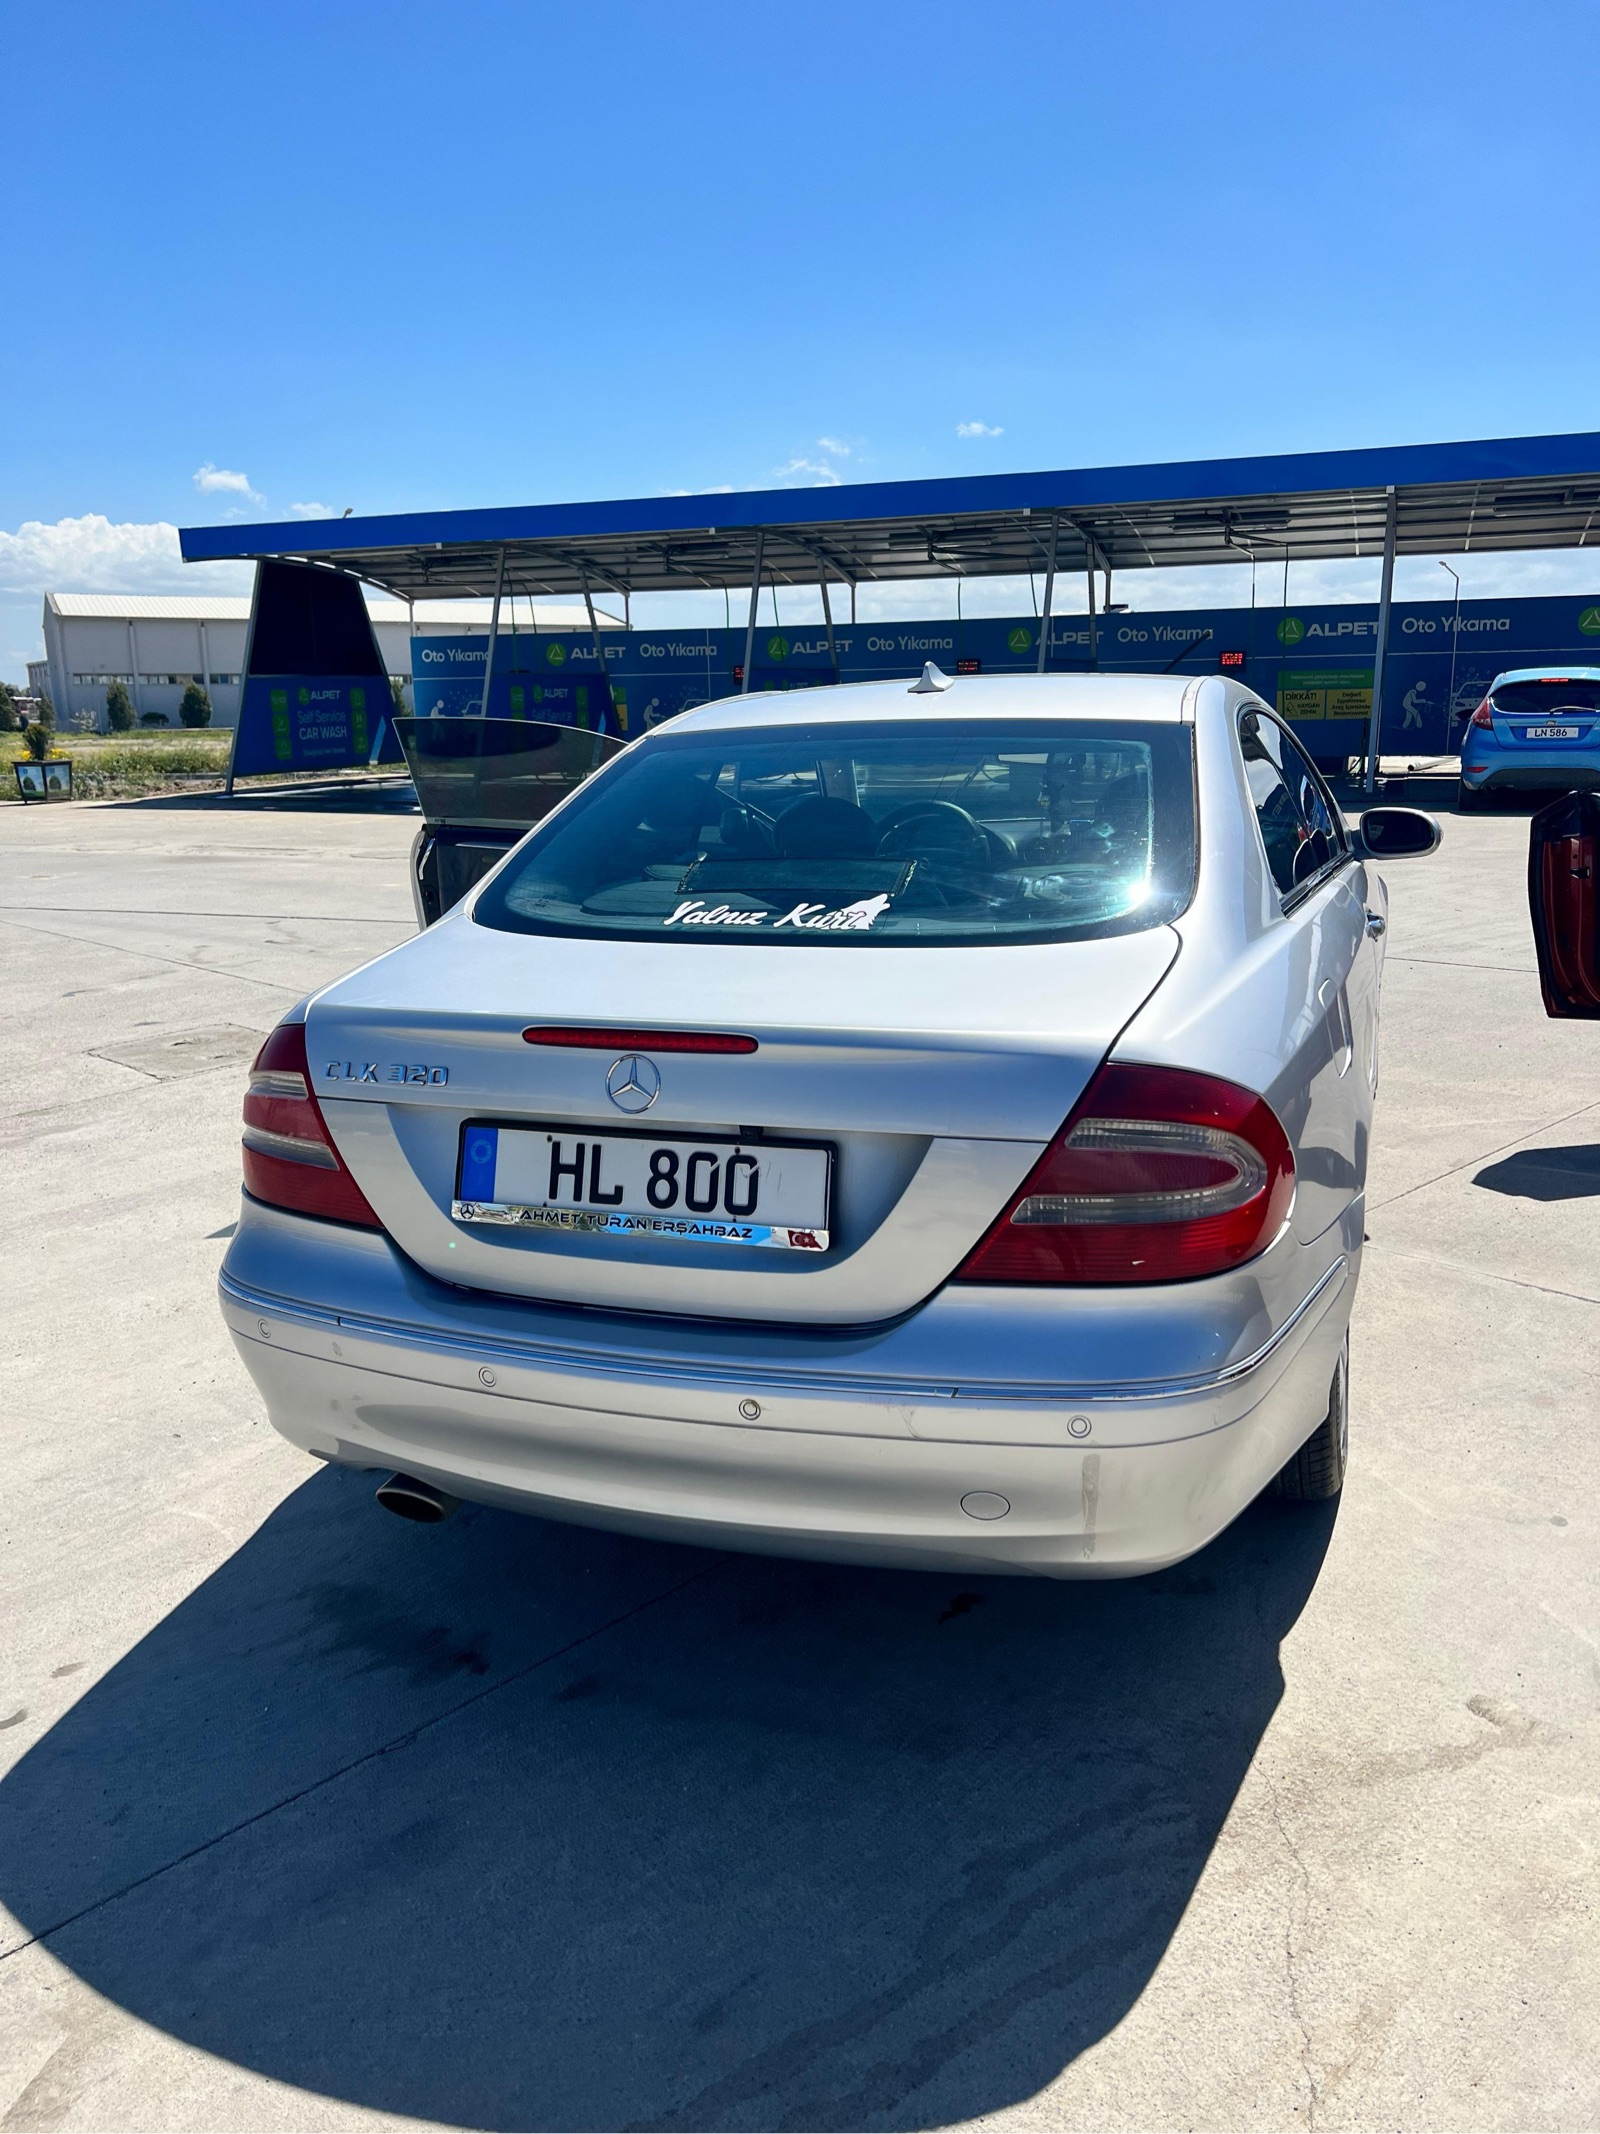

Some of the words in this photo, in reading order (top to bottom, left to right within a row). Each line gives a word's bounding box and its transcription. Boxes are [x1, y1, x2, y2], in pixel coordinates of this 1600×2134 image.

[1306, 621, 1379, 637] ALPET
[1401, 617, 1437, 634] Oto
[1441, 616, 1510, 633] Yıkama
[1117, 627, 1149, 643] Oto
[640, 643, 665, 657] Oto
[667, 642, 717, 657] Yıkama
[867, 636, 895, 651] Oto
[898, 635, 953, 650] Yıkama
[421, 649, 445, 663] Oto
[311, 690, 341, 700] ALPET
[544, 688, 569, 698] ALPET
[297, 710, 314, 724] Self
[315, 709, 346, 723] Service
[300, 727, 319, 740] CAR
[320, 725, 347, 739] WASH
[1534, 728, 1548, 737] LN
[1549, 728, 1567, 737] 586
[663, 901, 768, 925] Yalnız
[773, 902, 867, 930] Kurt
[322, 1060, 378, 1084] CLK
[388, 1063, 449, 1087] 320
[548, 1140, 624, 1205] HL
[646, 1149, 760, 1217] 800
[520, 1209, 580, 1223] AHMET
[586, 1215, 647, 1230] TURAN
[652, 1220, 753, 1239] ERŞAHBAZ
